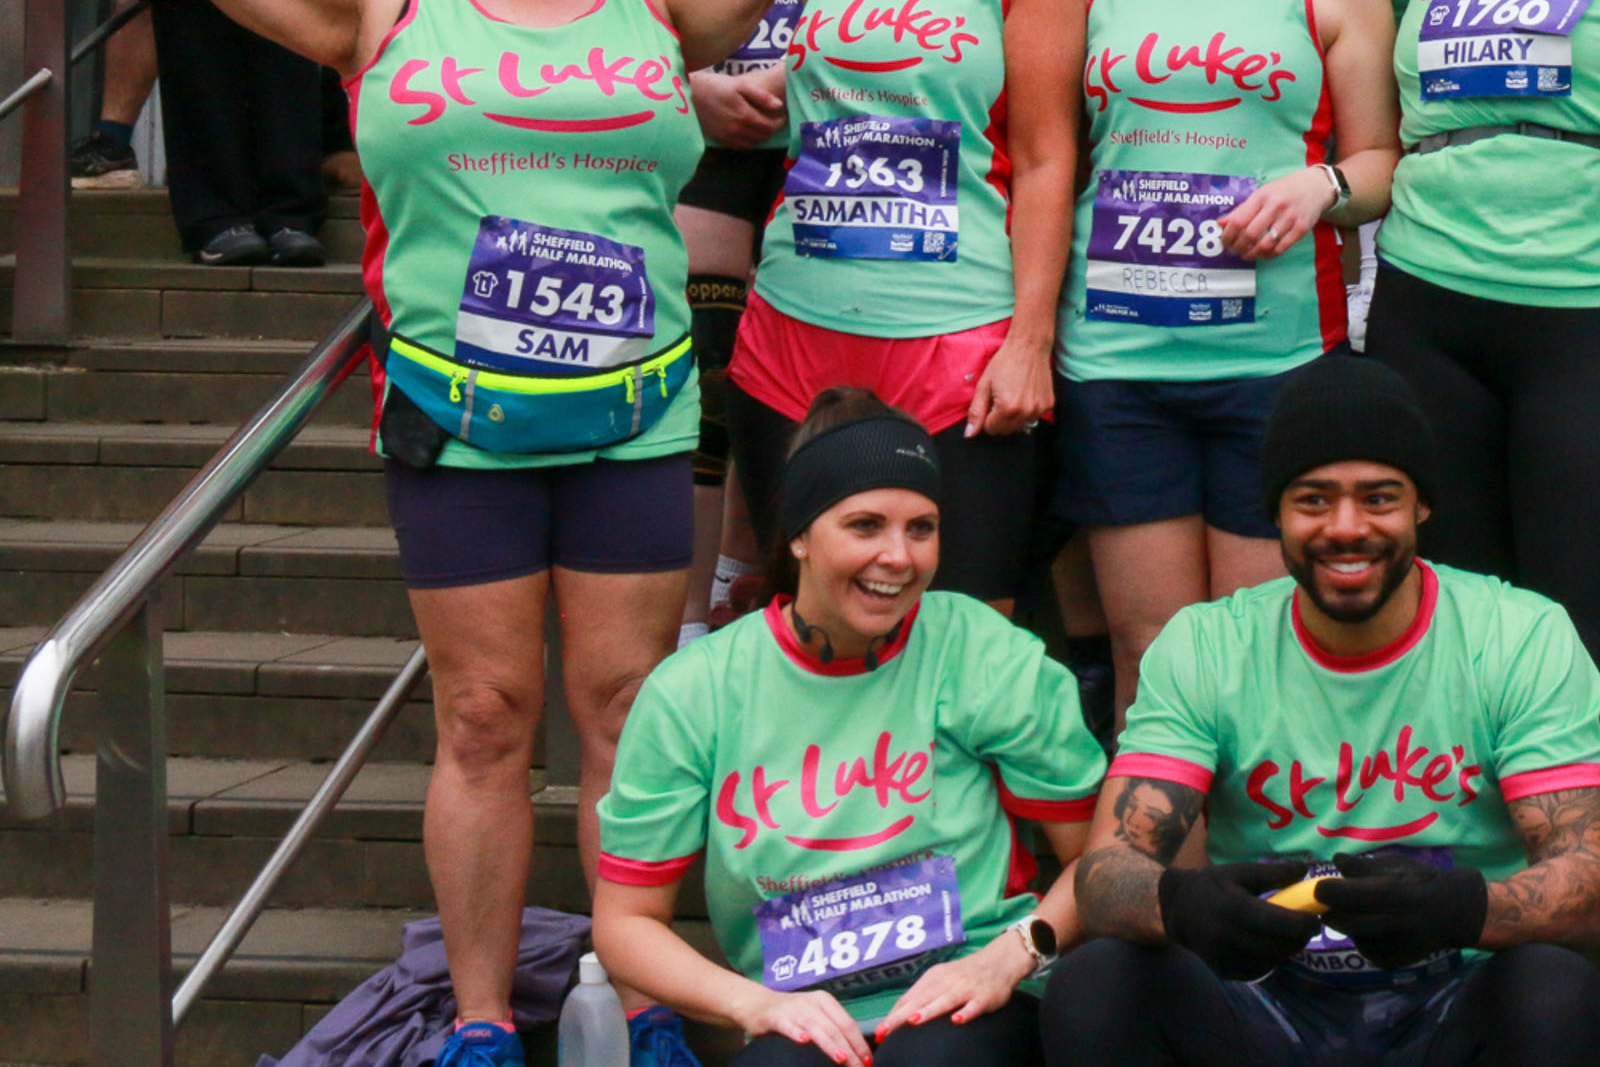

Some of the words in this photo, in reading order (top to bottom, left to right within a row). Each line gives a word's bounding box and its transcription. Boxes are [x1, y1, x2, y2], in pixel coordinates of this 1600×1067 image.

[747, 18, 794, 50] 26
[1135, 32, 1296, 102] Luke's
[1444, 38, 1534, 65] HILARY
[389, 56, 485, 125] St
[498, 47, 690, 115] Luke's
[877, 89, 928, 107] Hospice
[862, 132, 935, 147] MARATHON
[1186, 131, 1248, 150] Hospice
[447, 152, 566, 176] Sheffield's
[573, 153, 658, 174] Hospice
[825, 154, 924, 193] 1363
[1139, 179, 1189, 191] SHEFFIELD
[1139, 192, 1158, 203] HALF
[1160, 192, 1234, 206] MARATHON
[793, 197, 950, 228] SAMANTHA
[533, 233, 595, 253] SHEFFIELD
[1113, 215, 1224, 258] 7428
[530, 245, 563, 261] HALF
[566, 253, 632, 272] MARATHON
[506, 269, 624, 325] 1543
[515, 329, 589, 362] SAM
[1246, 759, 1326, 830] St
[1336, 725, 1482, 812] Luke's
[716, 766, 789, 850] St
[811, 882, 877, 908] SHEFFIELD
[813, 903, 848, 922] HALF
[850, 883, 932, 912] MARATHON
[798, 914, 927, 977] 4878
